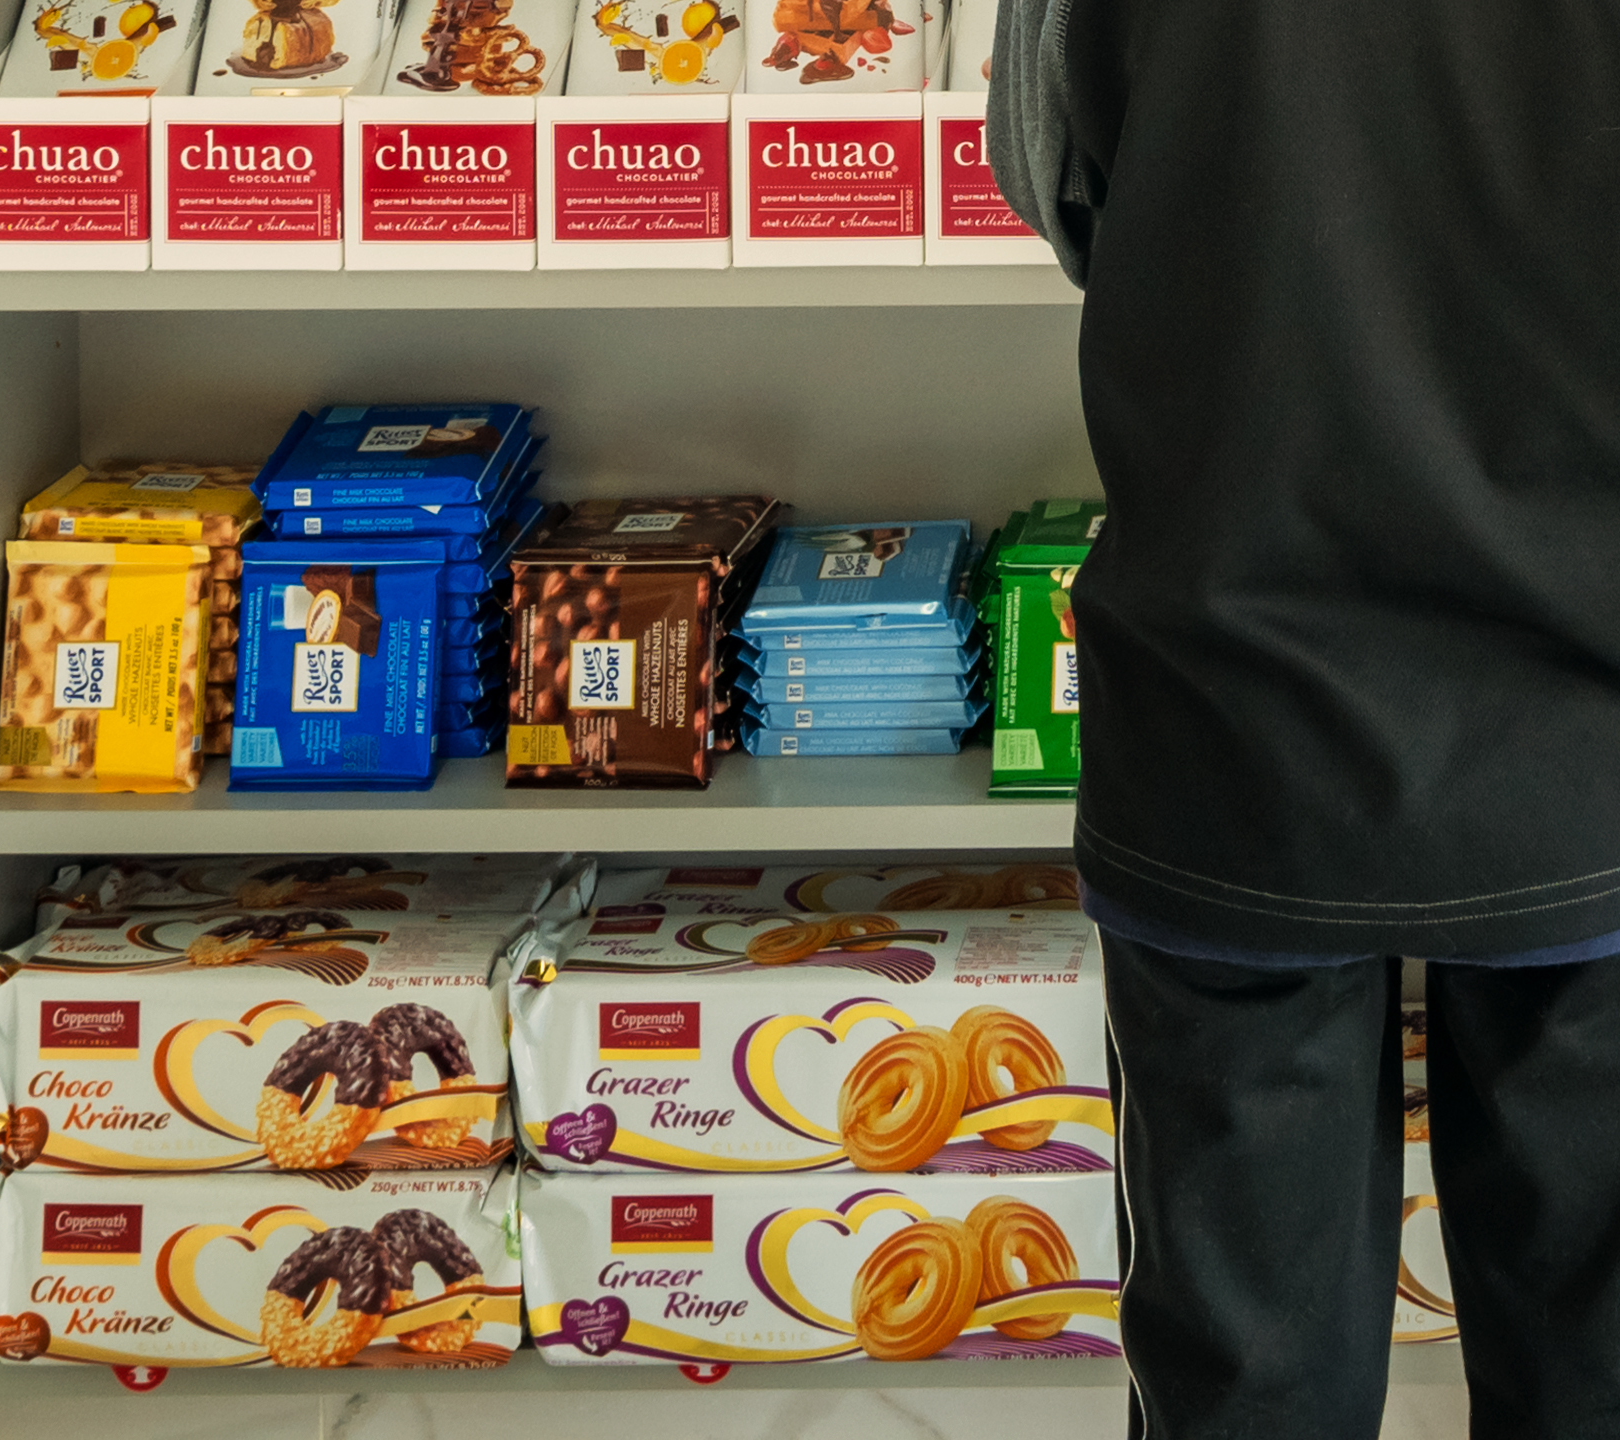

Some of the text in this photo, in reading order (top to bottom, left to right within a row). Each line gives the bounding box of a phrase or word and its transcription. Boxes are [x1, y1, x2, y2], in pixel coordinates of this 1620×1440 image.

[180, 130, 313, 171] chuao
[567, 129, 700, 171] chuao
[762, 127, 895, 168] chuao
[35, 176, 118, 184] CHOCOLATIER
[811, 171, 894, 180] CHOCOLATIER
[23, 196, 72, 206] handcrafted
[76, 197, 120, 206] chocolate
[62, 647, 86, 703] Ritter
[89, 647, 104, 703] SPORT
[580, 647, 603, 703] Ritter
[606, 646, 620, 701] SPORT
[52, 1008, 125, 1029] Coppenrath
[612, 1008, 684, 1029] Coppenrath
[28, 1070, 113, 1099] Choco
[586, 1067, 689, 1098] Grazer
[63, 1103, 170, 1131] Kränze
[651, 1101, 735, 1133] Ringe
